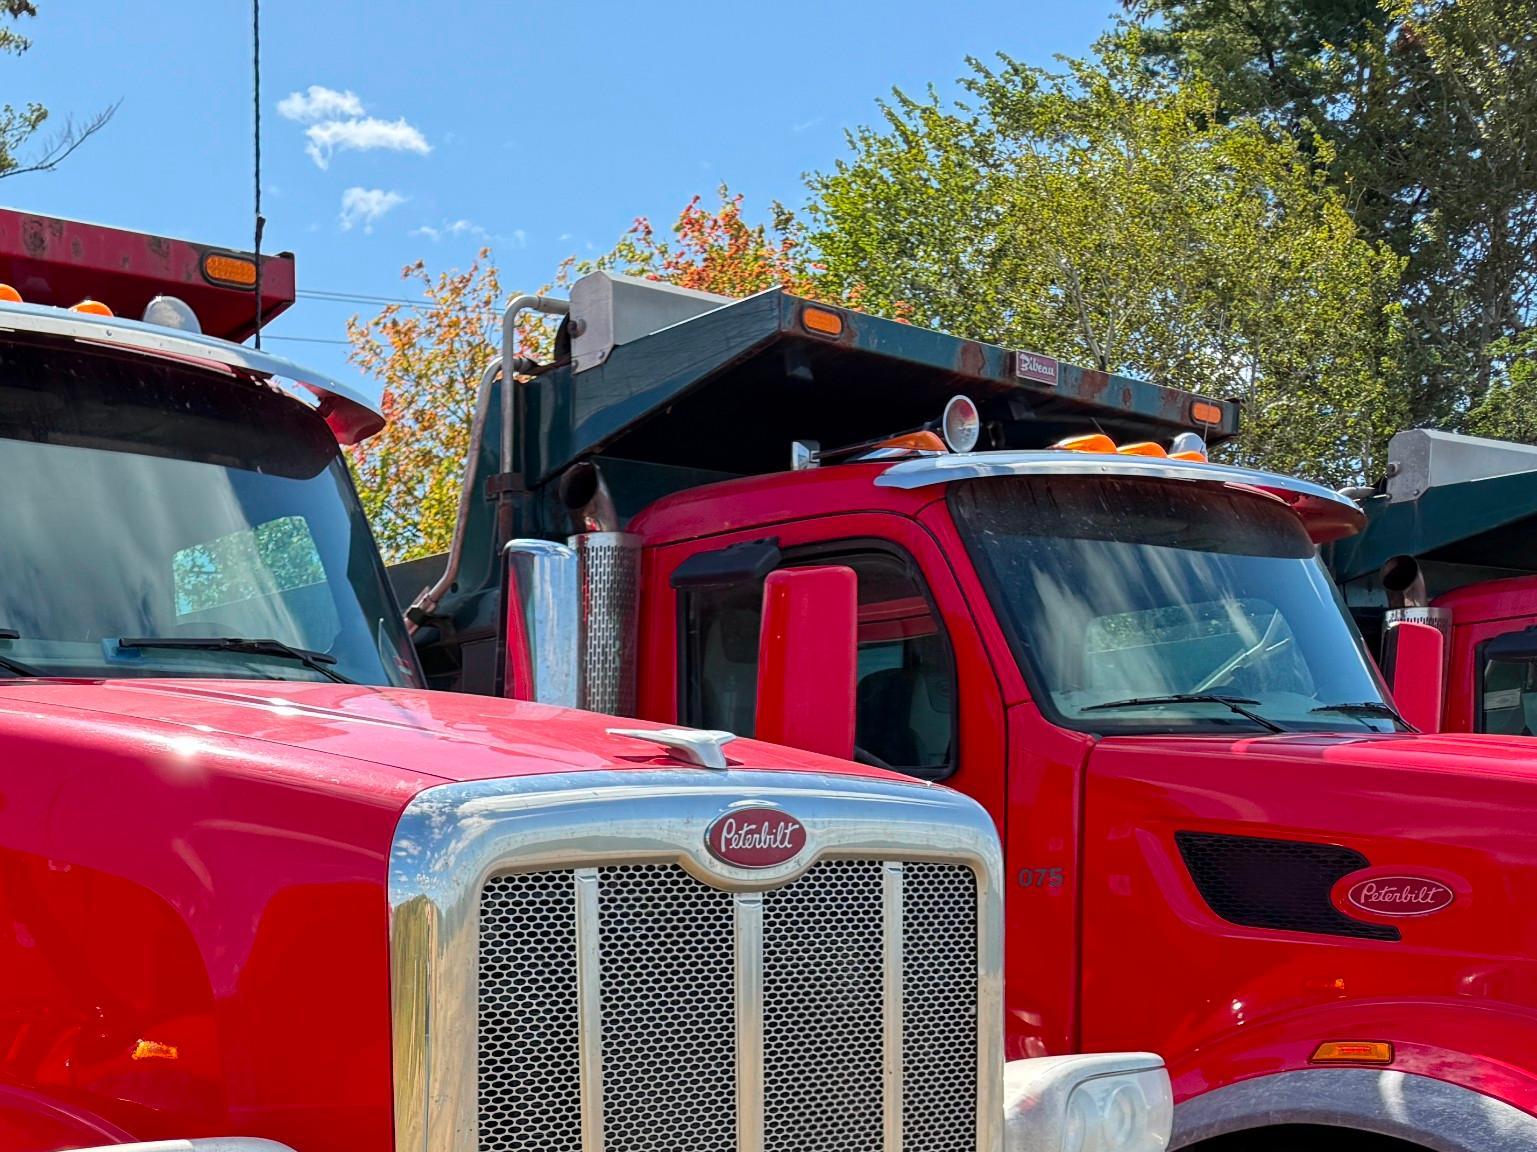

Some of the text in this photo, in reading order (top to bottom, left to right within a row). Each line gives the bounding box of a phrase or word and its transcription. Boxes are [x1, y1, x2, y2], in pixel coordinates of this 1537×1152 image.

[1019, 353, 1055, 377] Bibeau
[720, 818, 800, 853] Peterbilt
[1018, 867, 1065, 888] 075
[1360, 882, 1444, 904] Peterbilt
